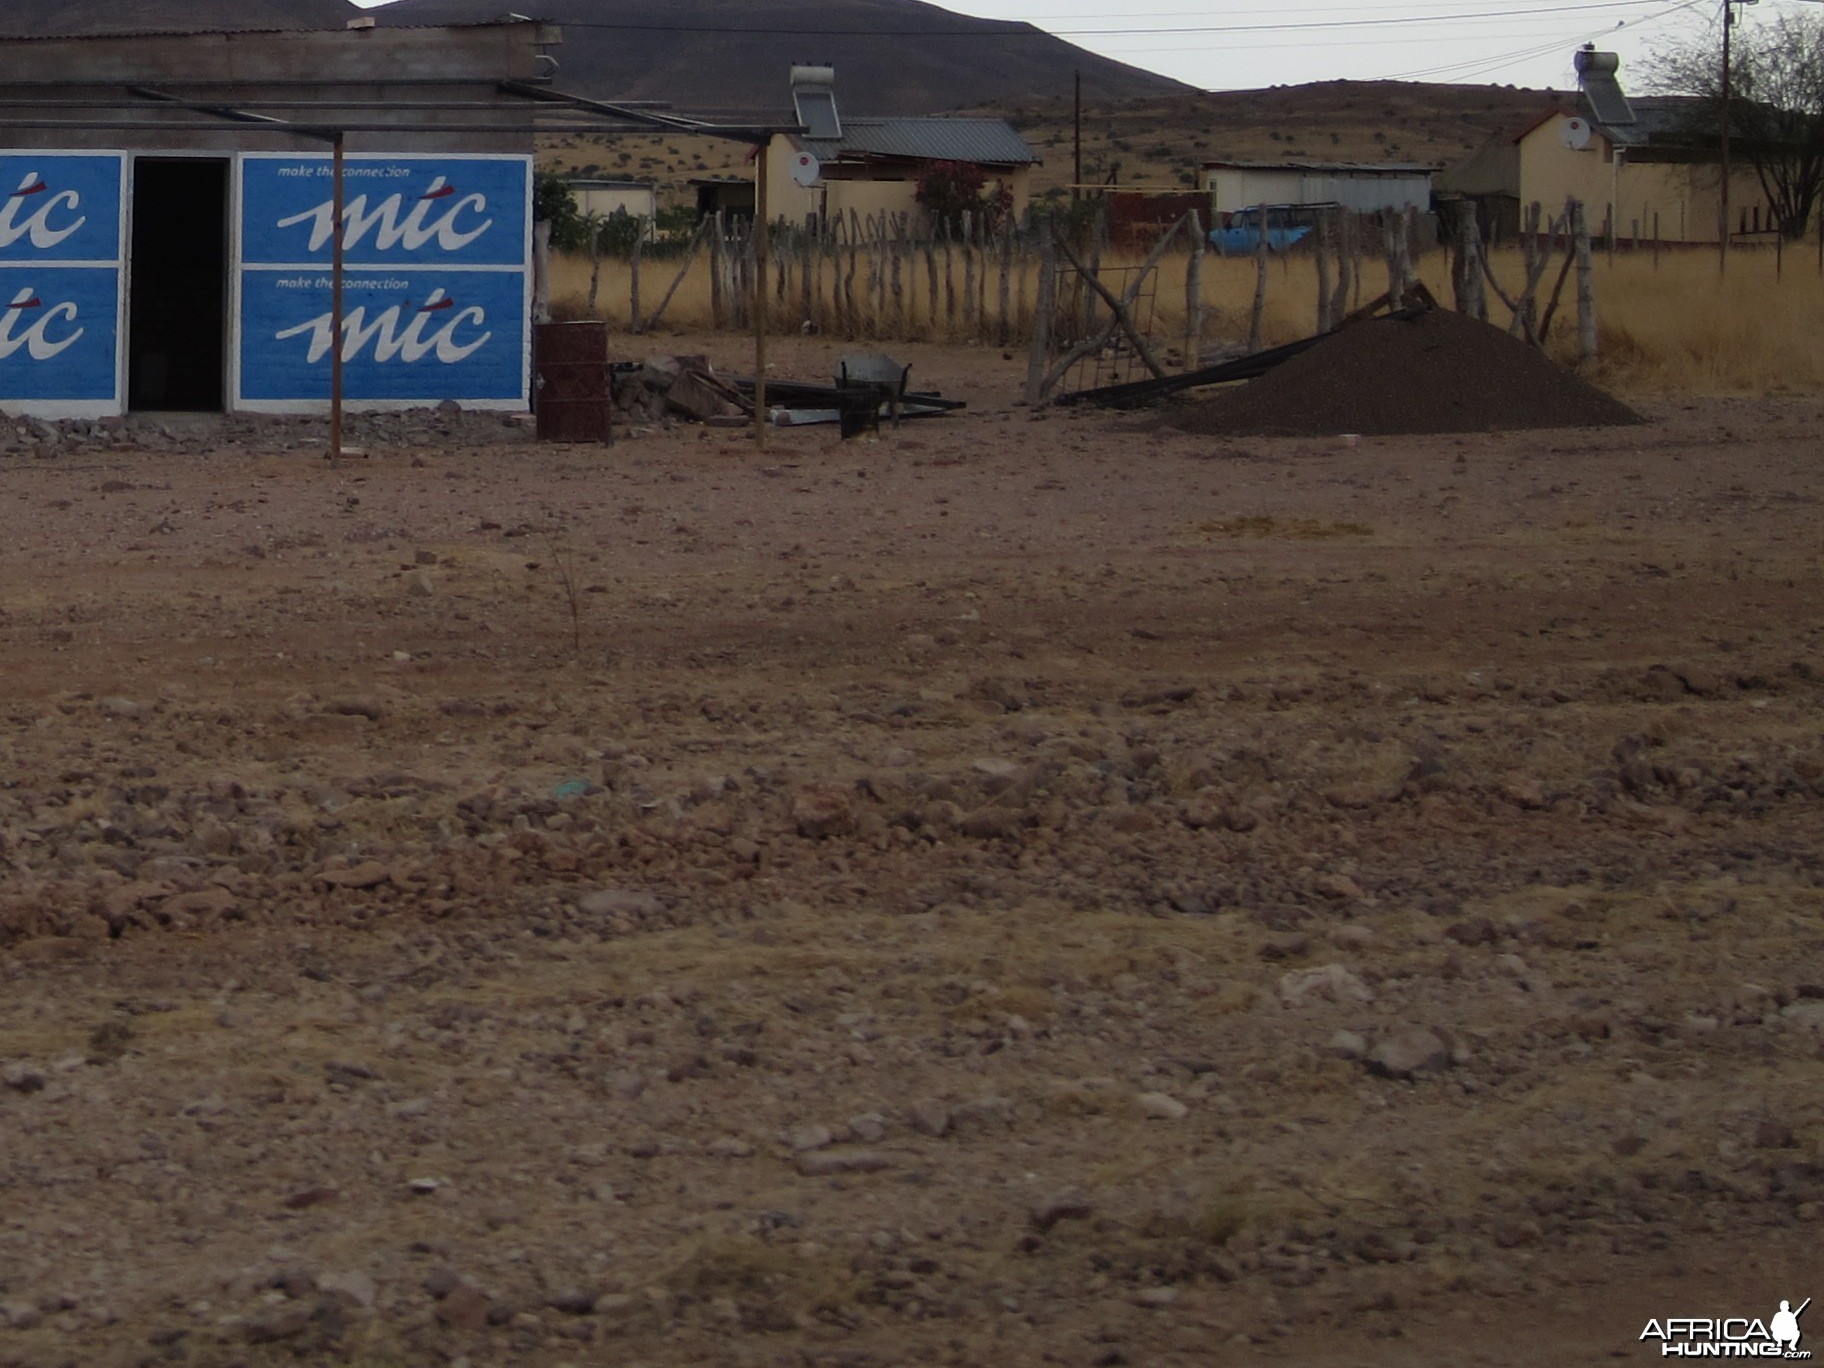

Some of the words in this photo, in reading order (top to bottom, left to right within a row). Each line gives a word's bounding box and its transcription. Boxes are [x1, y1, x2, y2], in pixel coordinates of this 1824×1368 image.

[277, 166, 314, 178] make
[341, 166, 410, 178] connection
[277, 176, 492, 251] mic
[276, 277, 313, 289] make
[275, 287, 491, 363] mic
